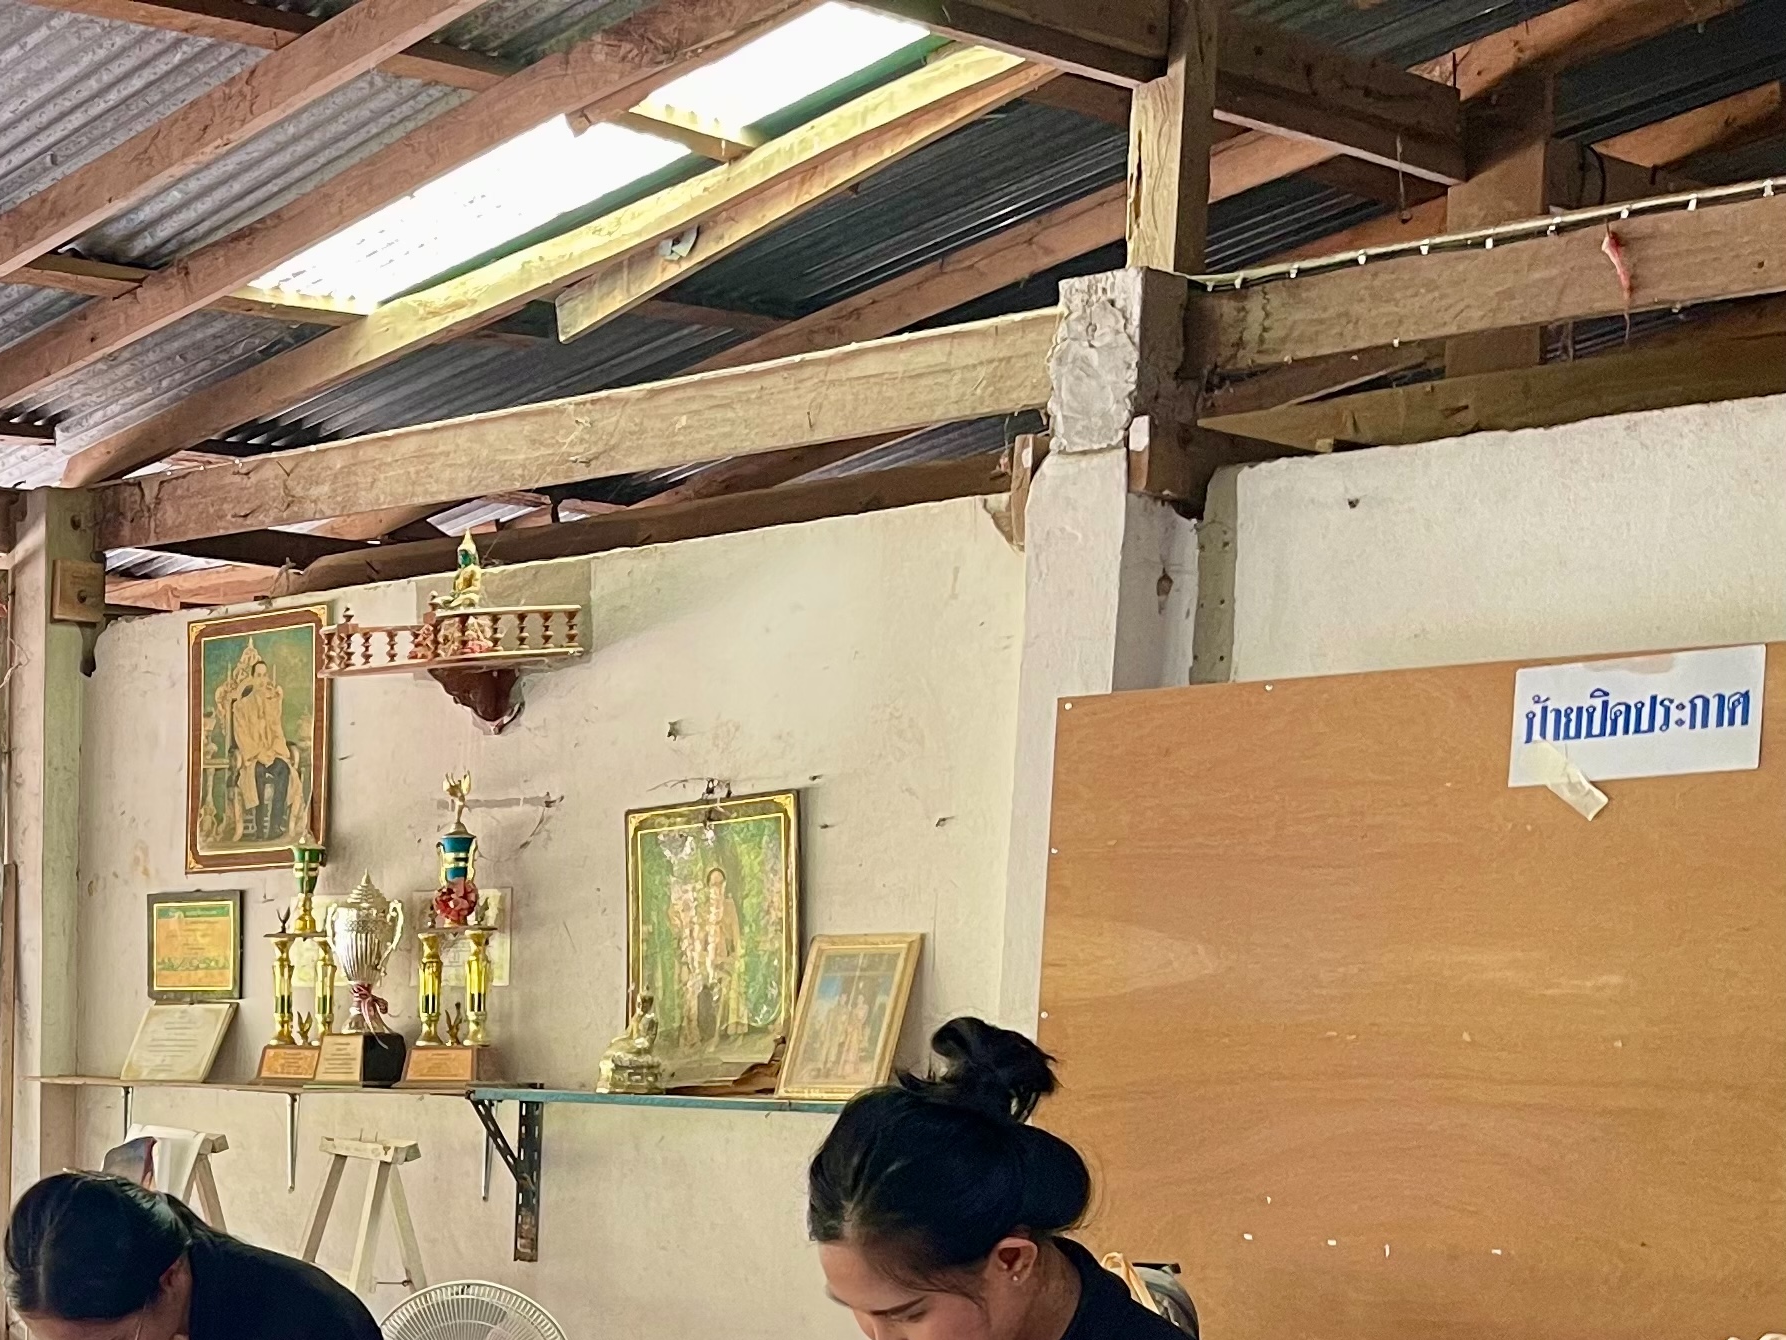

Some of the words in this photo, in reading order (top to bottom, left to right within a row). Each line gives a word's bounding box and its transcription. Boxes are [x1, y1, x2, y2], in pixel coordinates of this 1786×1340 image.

[1524, 687, 1751, 744] ป้ายปิดประกาศ
